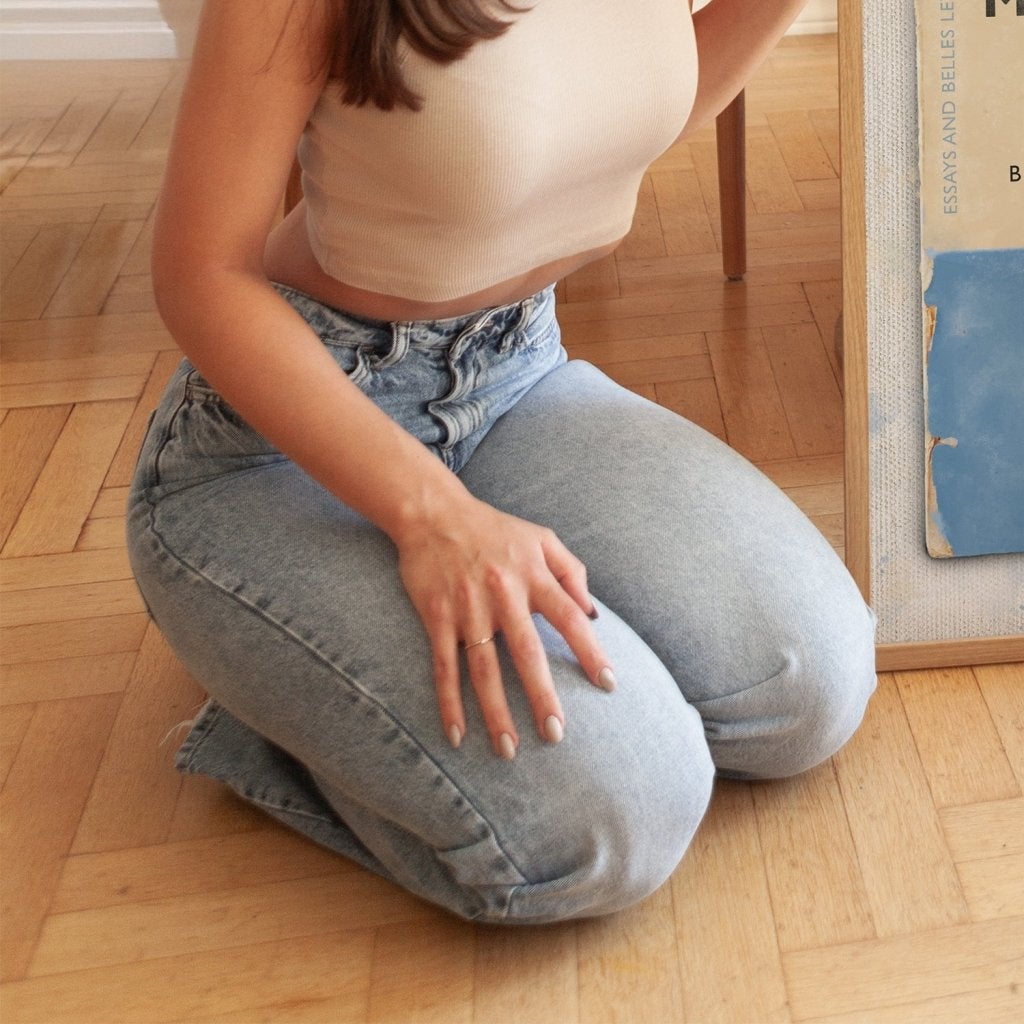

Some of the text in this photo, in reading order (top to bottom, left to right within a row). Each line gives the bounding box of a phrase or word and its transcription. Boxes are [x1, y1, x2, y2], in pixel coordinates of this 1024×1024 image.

[941, 29, 955, 93] BELLES
[942, 100, 956, 145] AND
[943, 150, 957, 214] ESSAYS
